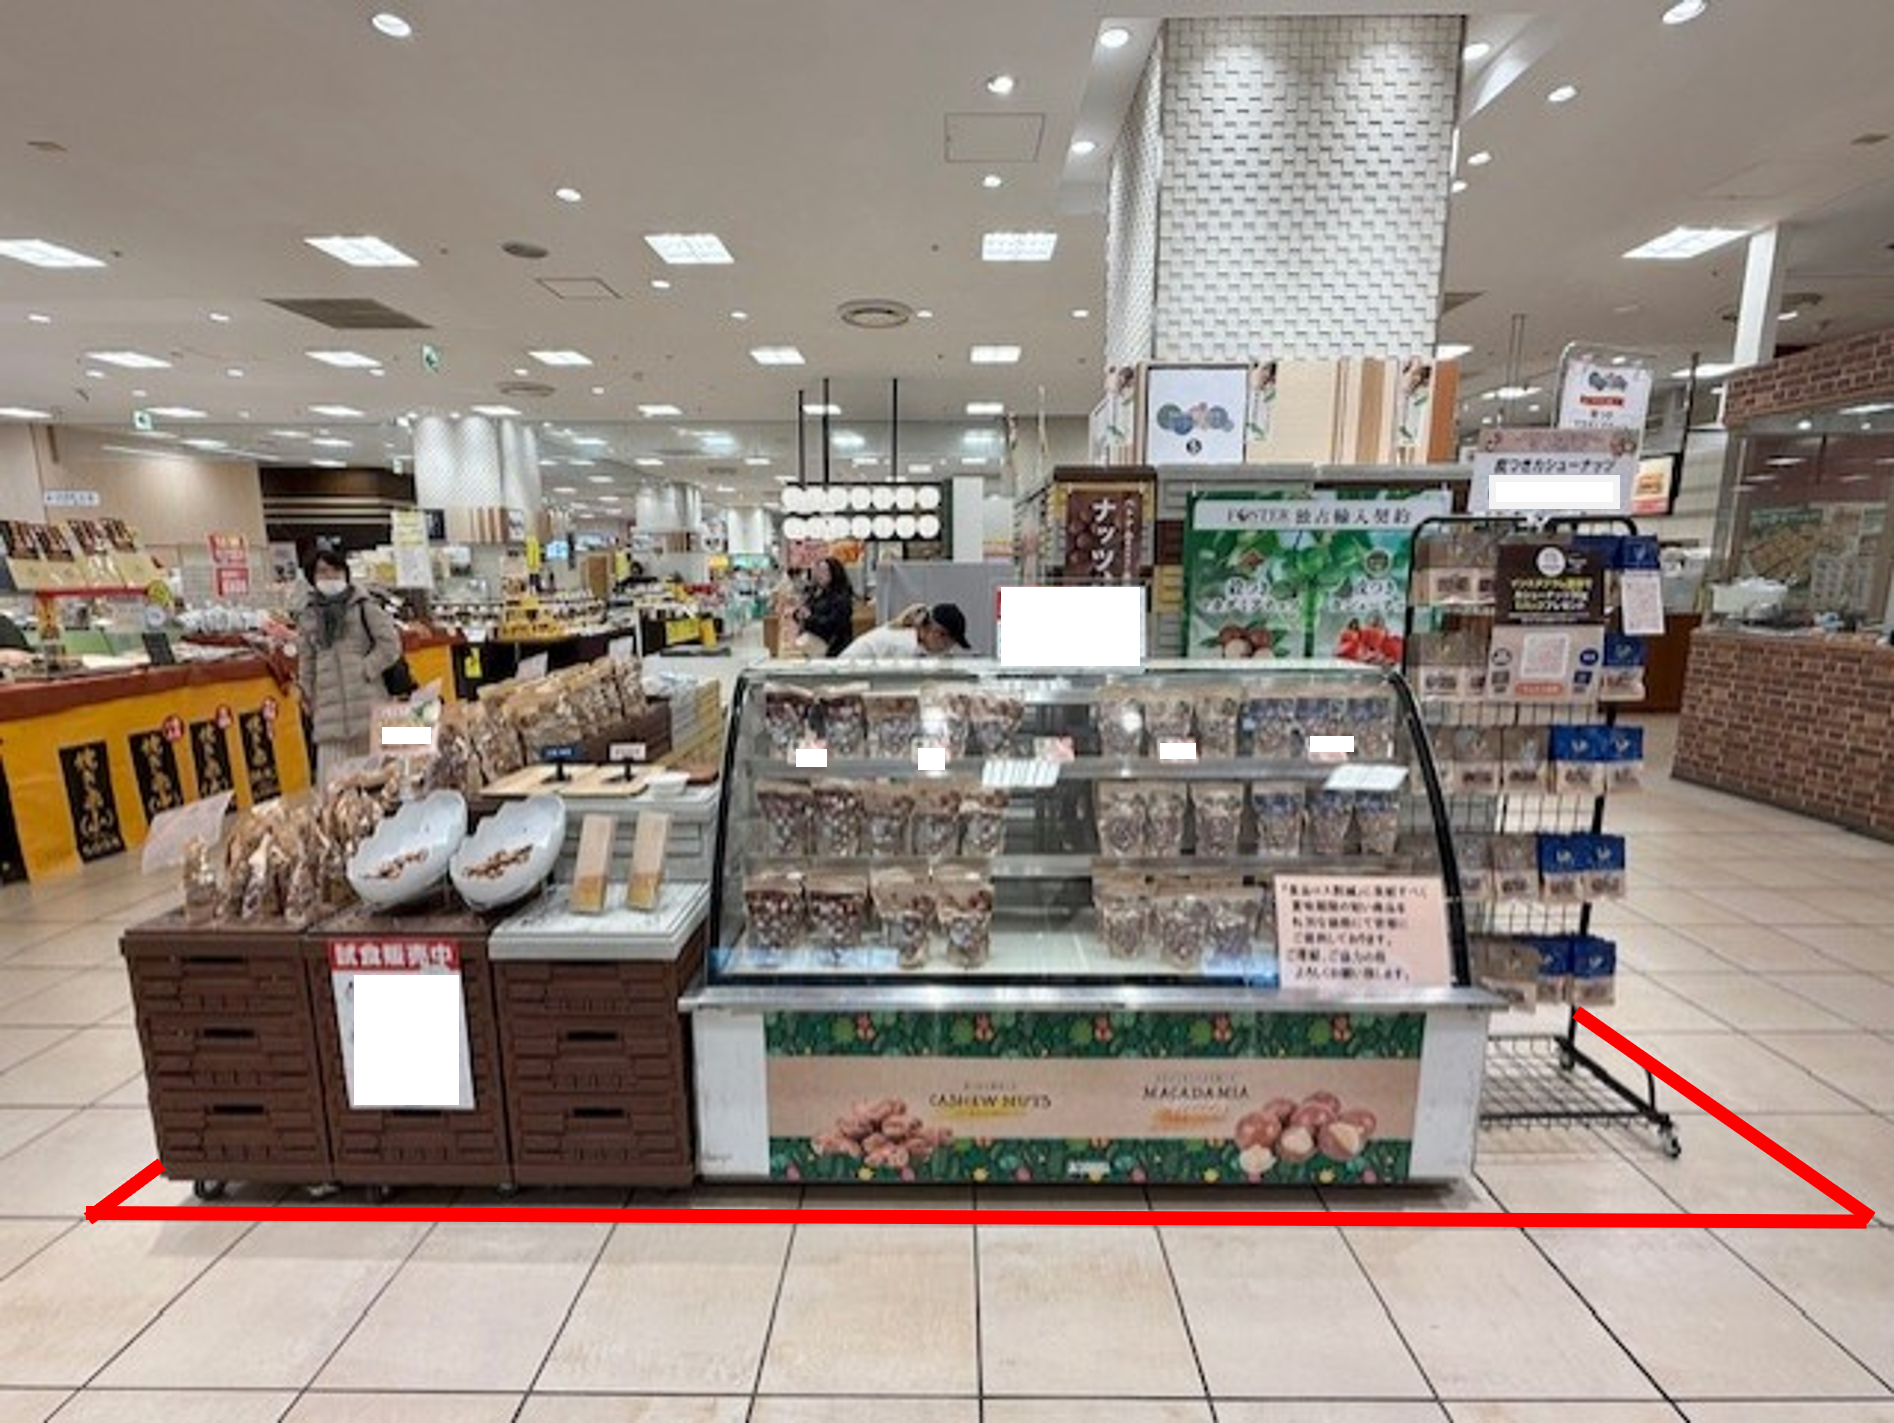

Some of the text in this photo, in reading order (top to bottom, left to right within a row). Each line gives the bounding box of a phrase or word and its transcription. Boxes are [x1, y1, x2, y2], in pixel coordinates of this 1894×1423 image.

[929, 1092, 1052, 1109] CASHEW NUTS
[1142, 1085, 1249, 1101] MACADAMIA
